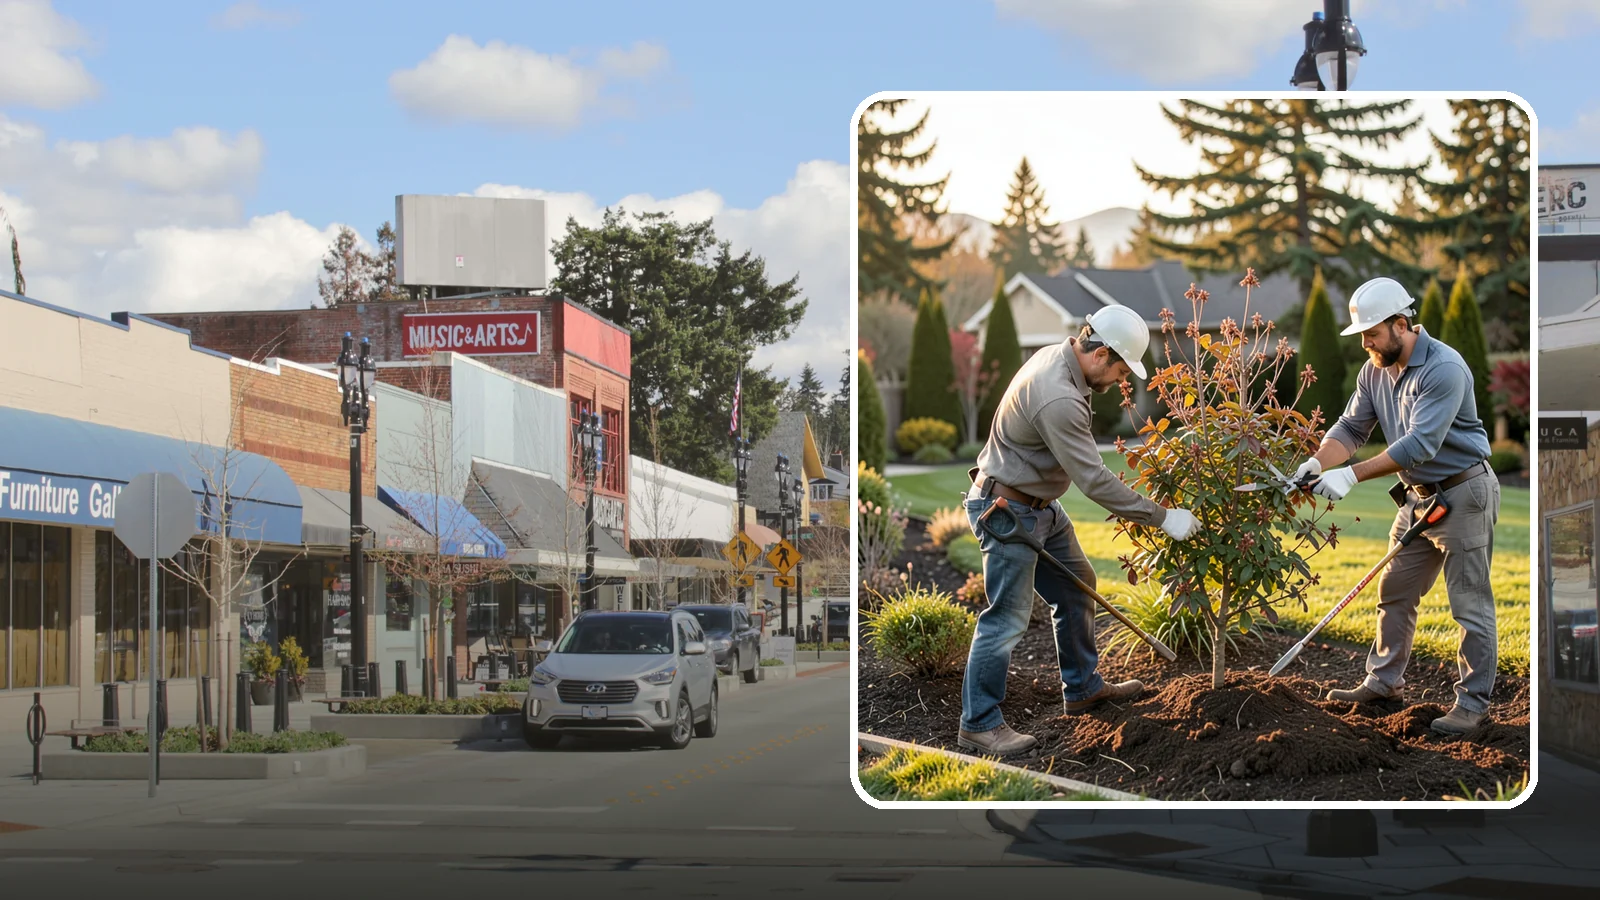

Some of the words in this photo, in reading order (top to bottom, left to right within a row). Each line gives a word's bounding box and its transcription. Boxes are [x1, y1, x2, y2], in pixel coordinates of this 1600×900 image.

[408, 322, 520, 349] MUSIC&ARTS
[1540, 427, 1578, 437] UGA
[0, 471, 79, 515] Furniture
[89, 482, 122, 519] Gal
